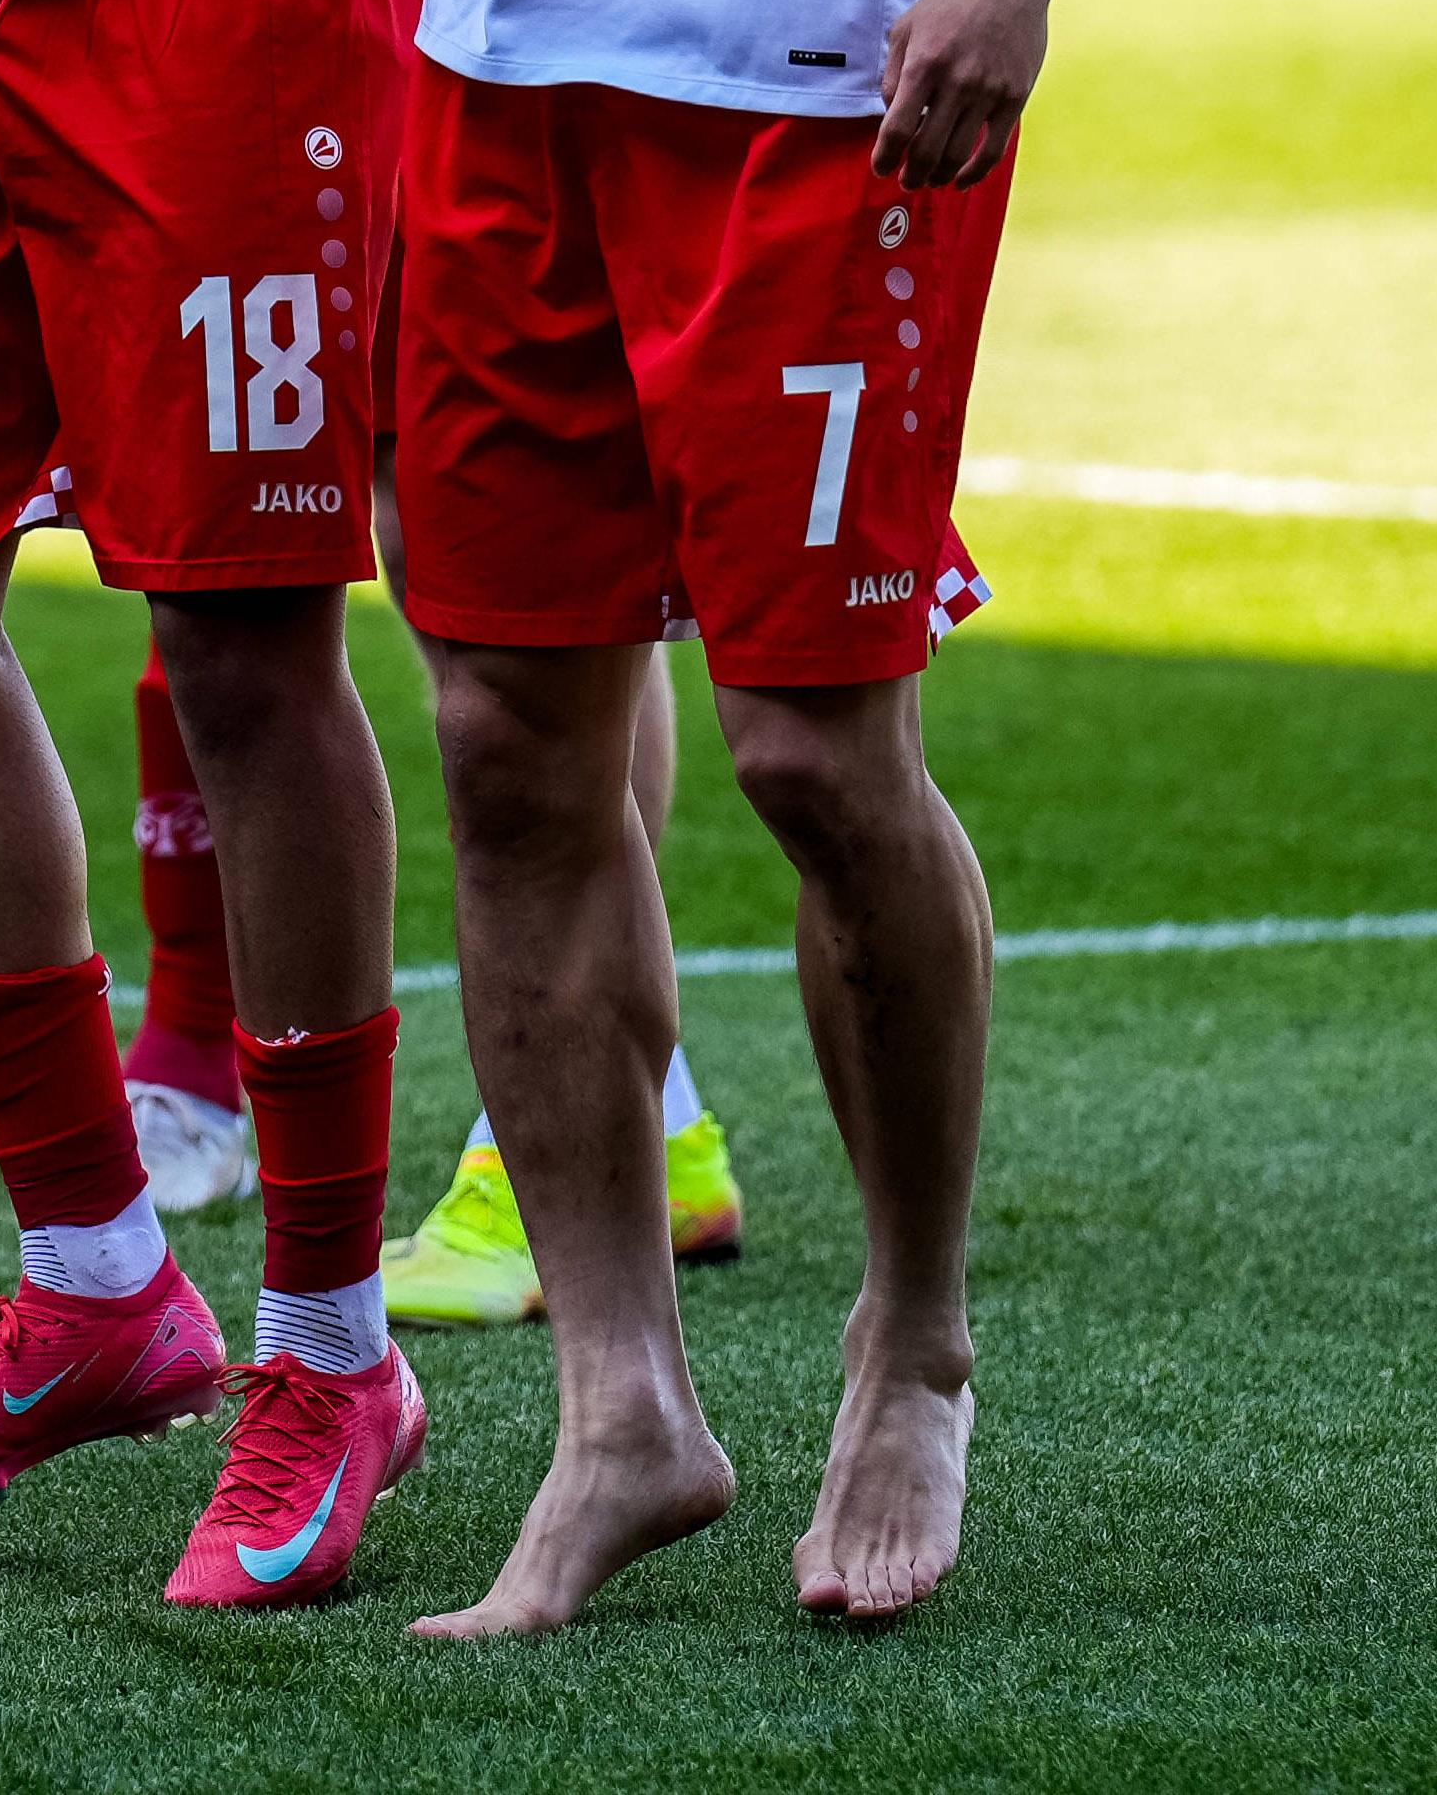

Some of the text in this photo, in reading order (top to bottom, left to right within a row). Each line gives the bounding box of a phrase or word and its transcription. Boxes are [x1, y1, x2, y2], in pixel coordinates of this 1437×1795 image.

[180, 273, 325, 453] 18
[251, 482, 343, 514] JAKO
[782, 362, 866, 546] 7
[845, 569, 915, 607] JAKO
